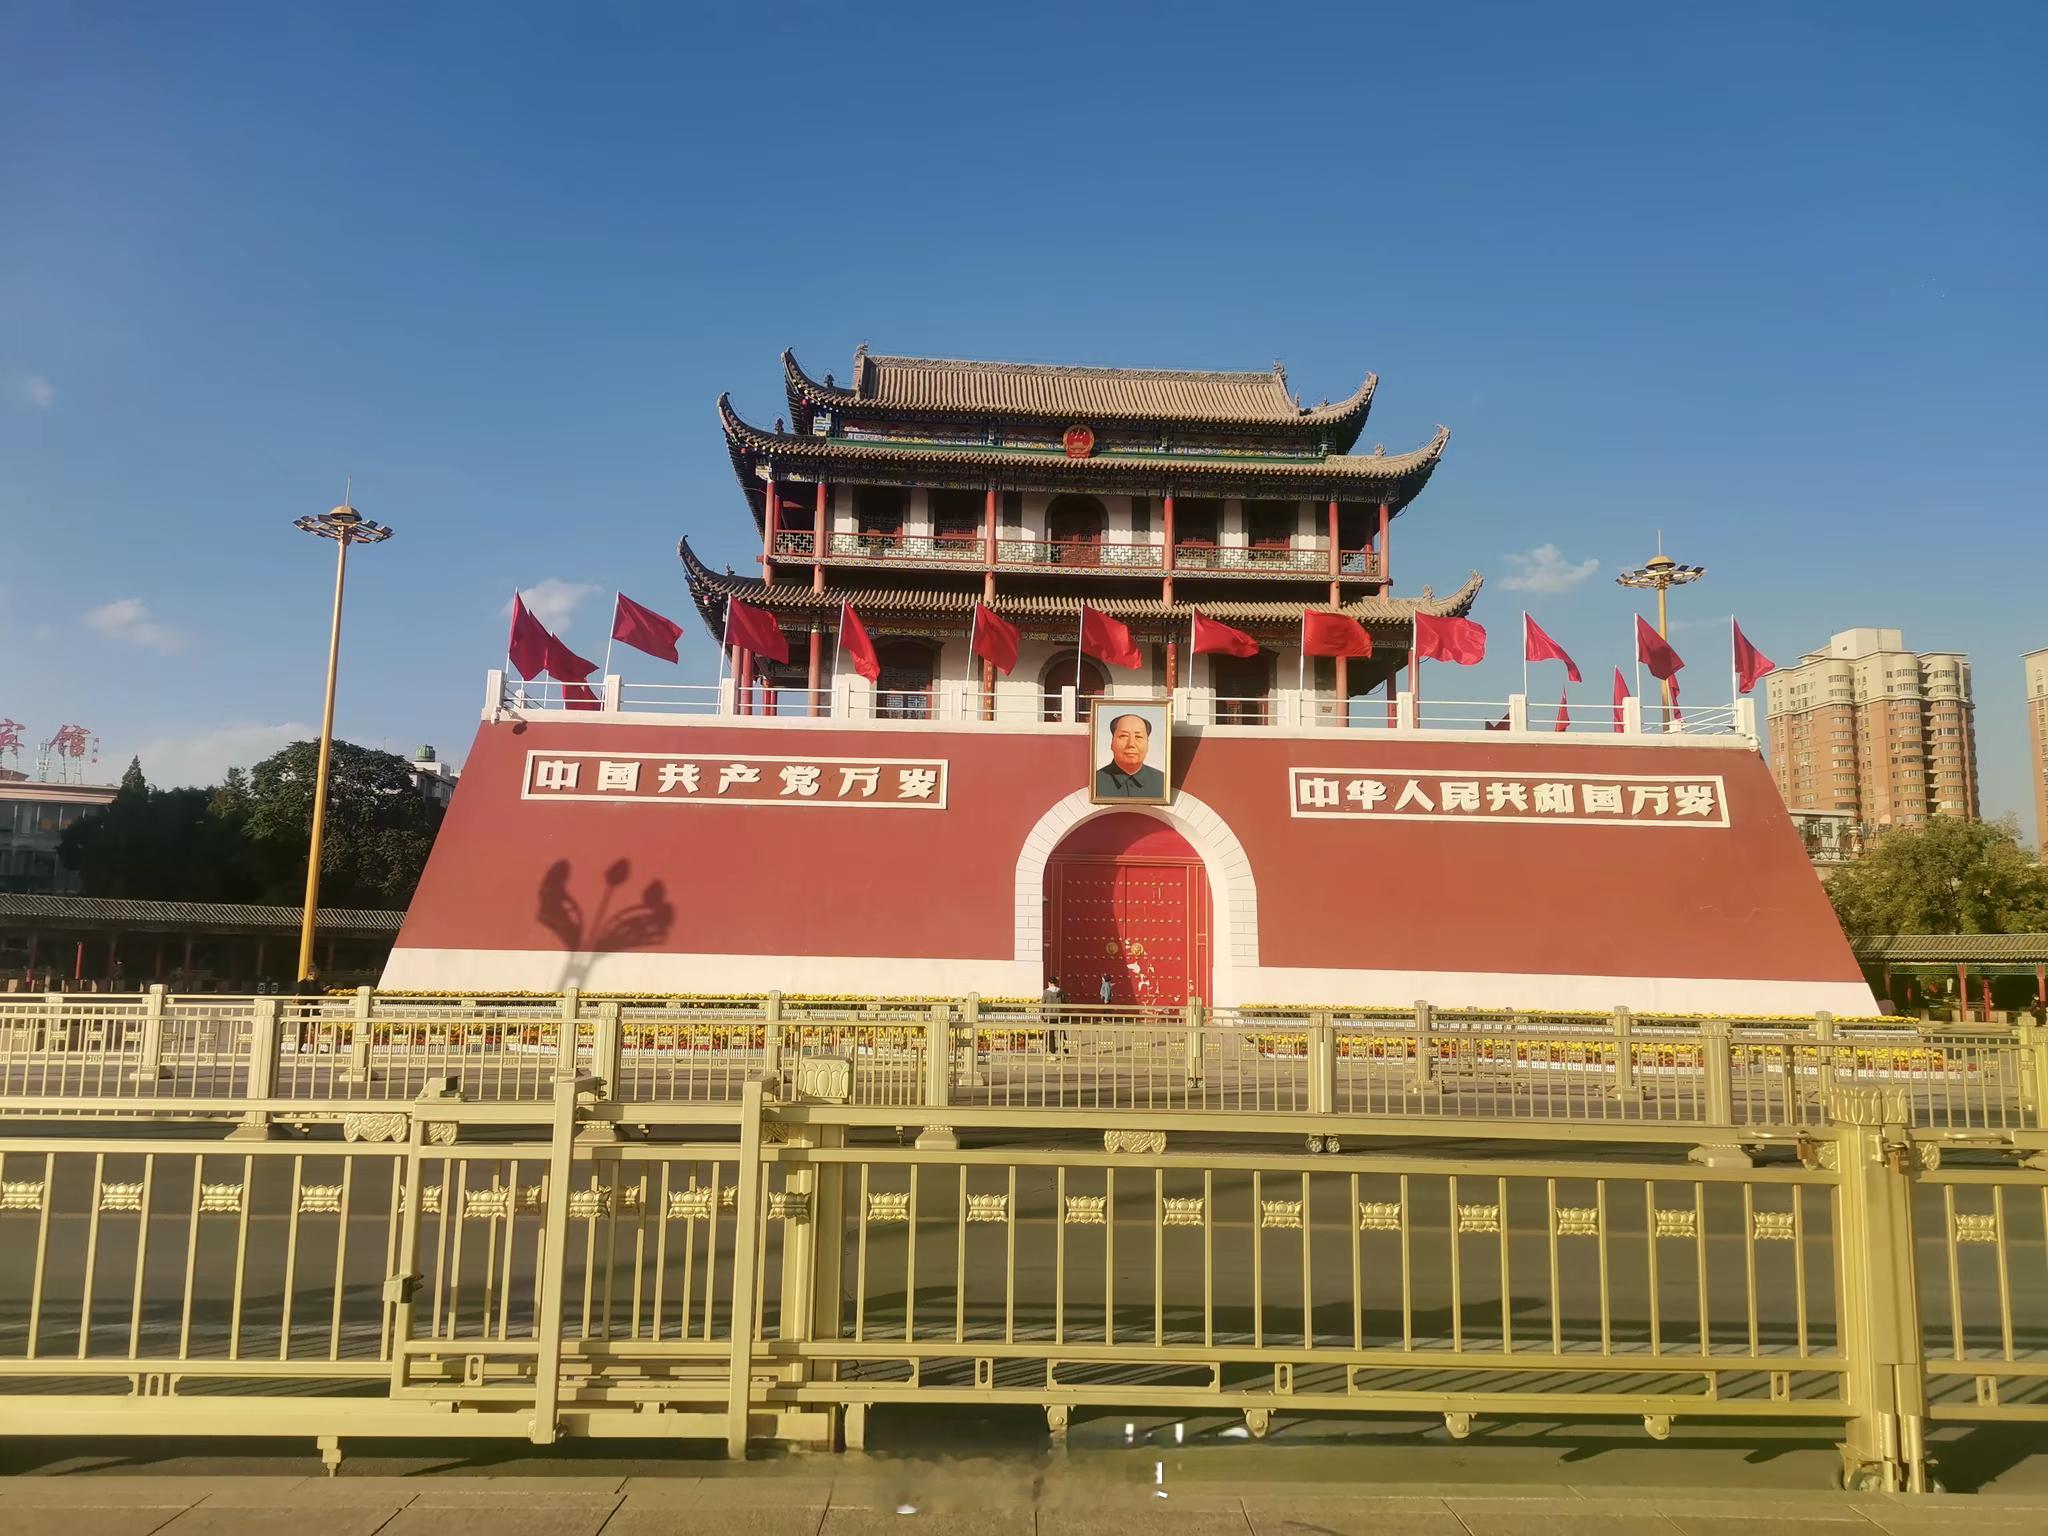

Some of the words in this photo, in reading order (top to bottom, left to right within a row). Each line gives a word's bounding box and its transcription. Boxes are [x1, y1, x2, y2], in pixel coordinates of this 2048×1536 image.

[535, 759, 938, 799] 中国共产党万岁
[1299, 777, 1716, 817] 中华人民共和国万岁
